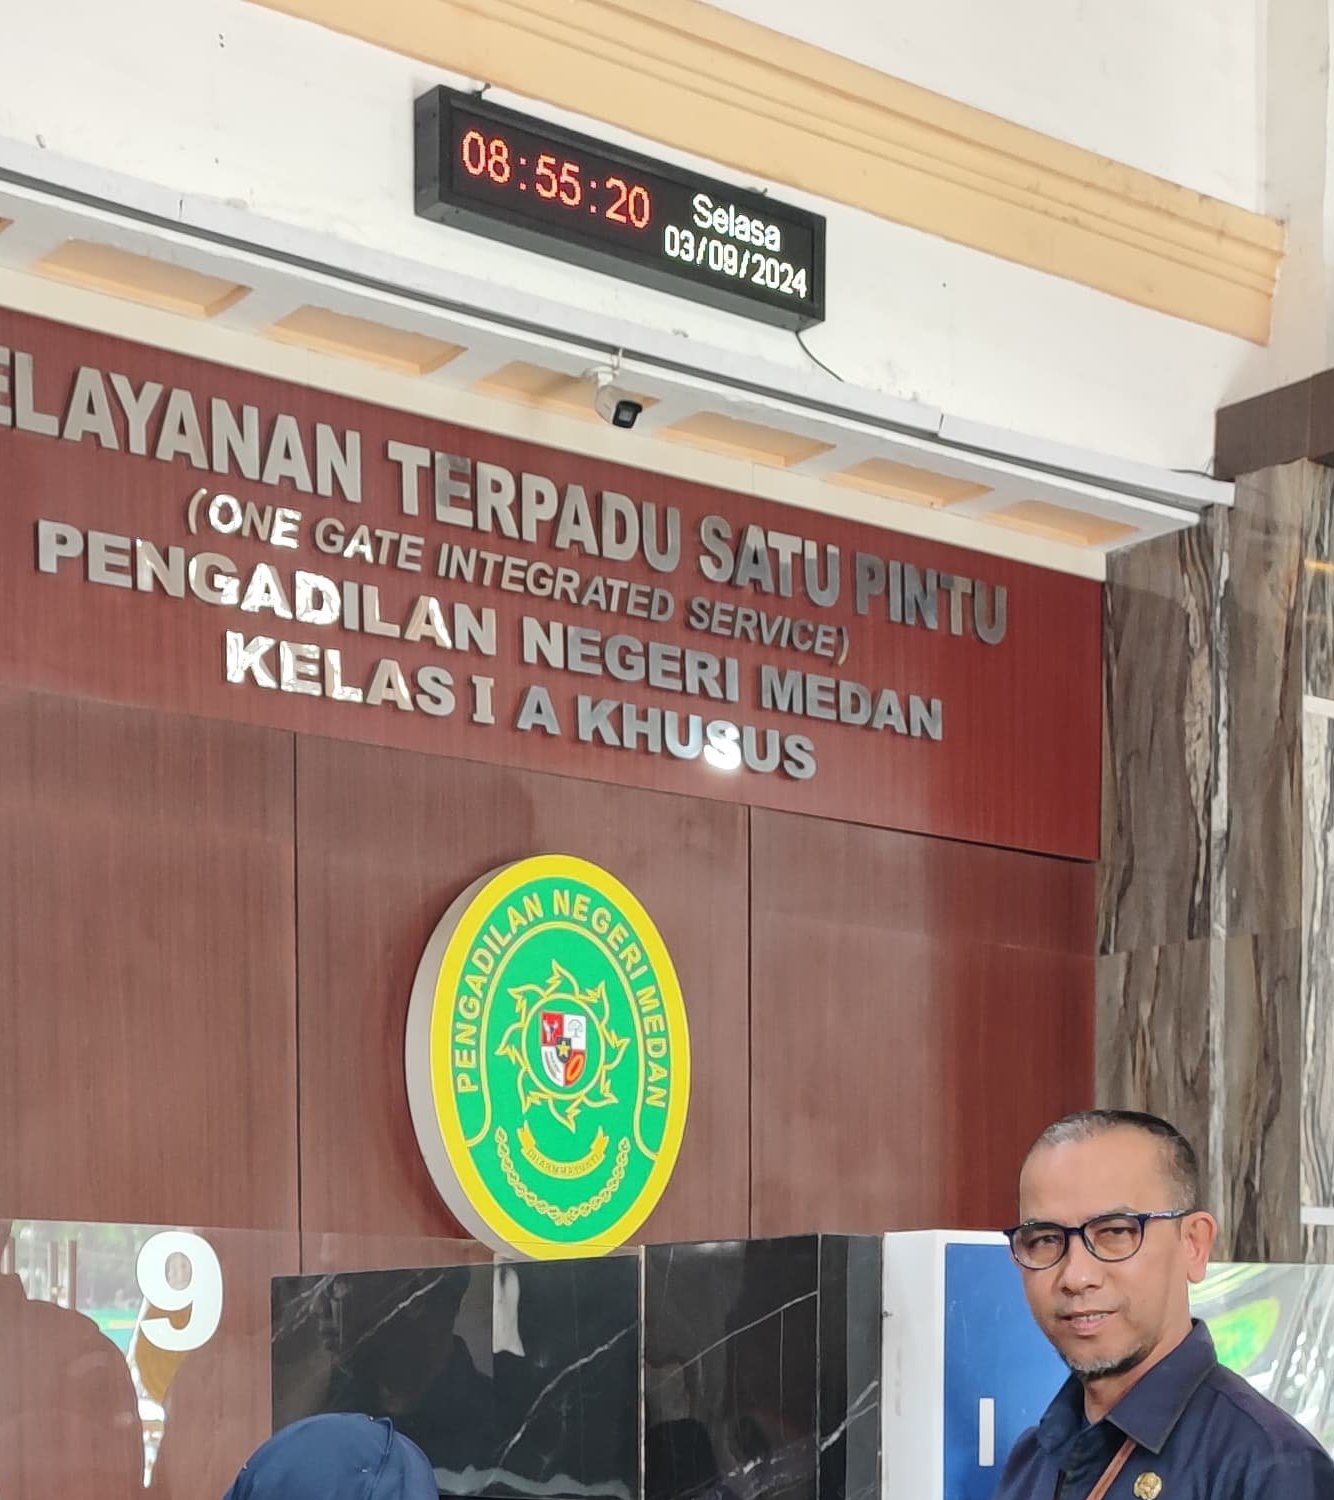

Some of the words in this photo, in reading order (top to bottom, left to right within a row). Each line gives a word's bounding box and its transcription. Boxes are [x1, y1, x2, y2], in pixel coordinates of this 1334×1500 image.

[462, 131, 650, 229] 08:55:20
[692, 193, 781, 252] Selasa
[664, 225, 807, 298] 03/09/2024
[187, 488, 302, 549] (ONE
[314, 517, 424, 572] GATE
[437, 542, 675, 622] INTEGRATED
[688, 595, 849, 665] SERVICE)
[387, 439, 681, 573] TERPADU
[698, 515, 841, 608] SATU
[854, 551, 1008, 645] PINTU
[37, 518, 497, 656] PENGADILAN
[522, 615, 739, 702] NEGERI
[761, 664, 943, 741] MEDAN
[225, 629, 456, 716] KELAS
[471, 674, 495, 725] I
[516, 685, 562, 736] A
[576, 693, 817, 781] KHUSUS
[455, 891, 544, 1093] PENGADILAN
[552, 888, 648, 981] NEGERI
[635, 985, 666, 1109] MEDAN
[137, 1231, 223, 1351] 9
